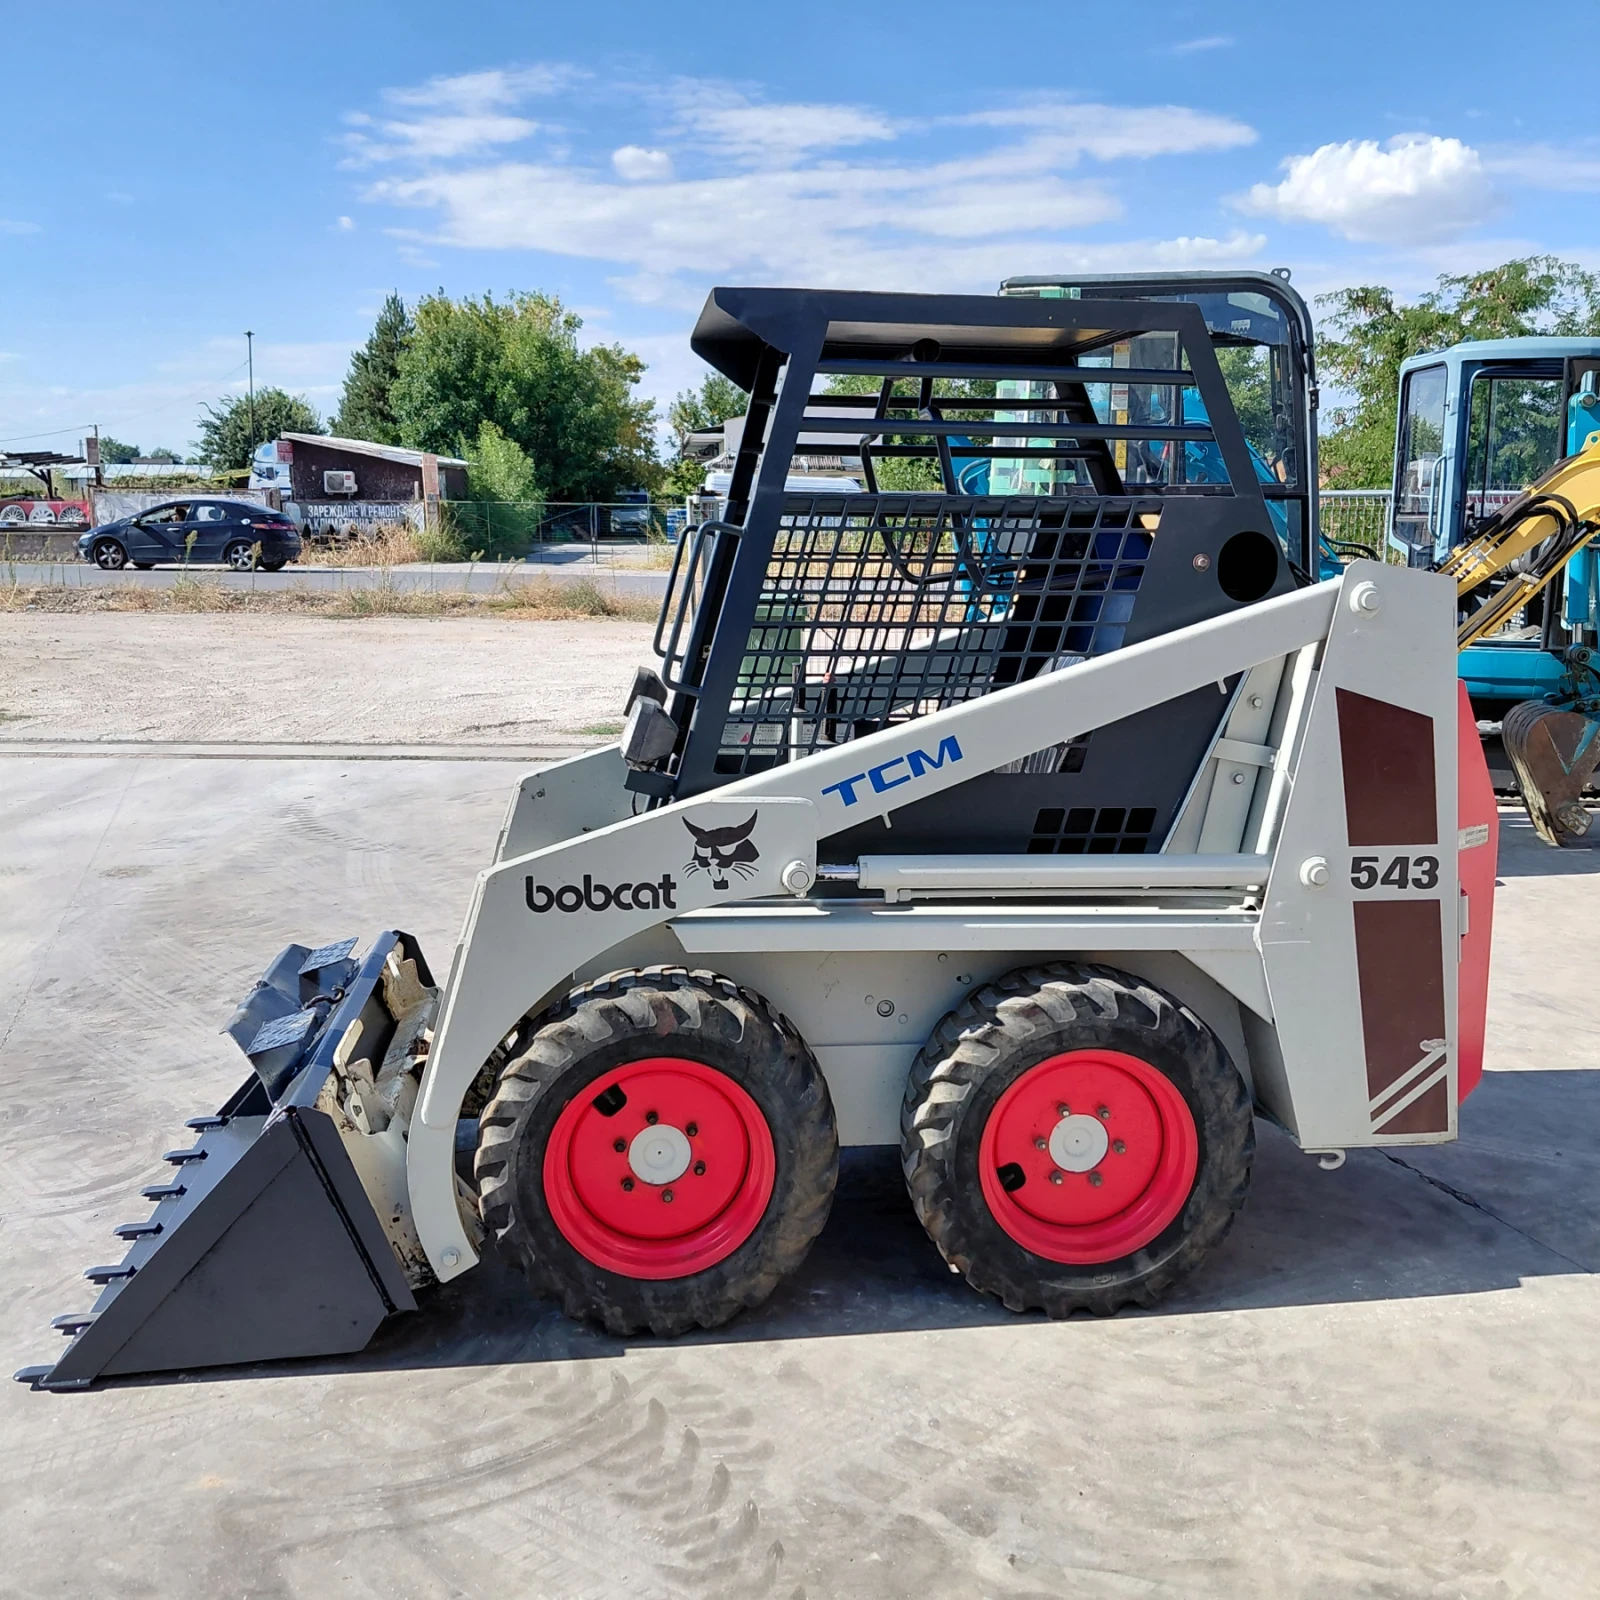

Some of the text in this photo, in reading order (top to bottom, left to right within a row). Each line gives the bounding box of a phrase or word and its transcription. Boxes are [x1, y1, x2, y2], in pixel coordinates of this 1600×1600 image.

[308, 505, 359, 518] ЗАРЕЖДАНЕ
[368, 505, 401, 518] РЕМОНТ
[821, 735, 963, 807] TCM
[1350, 855, 1440, 890] 543
[525, 873, 677, 914] bobcat
